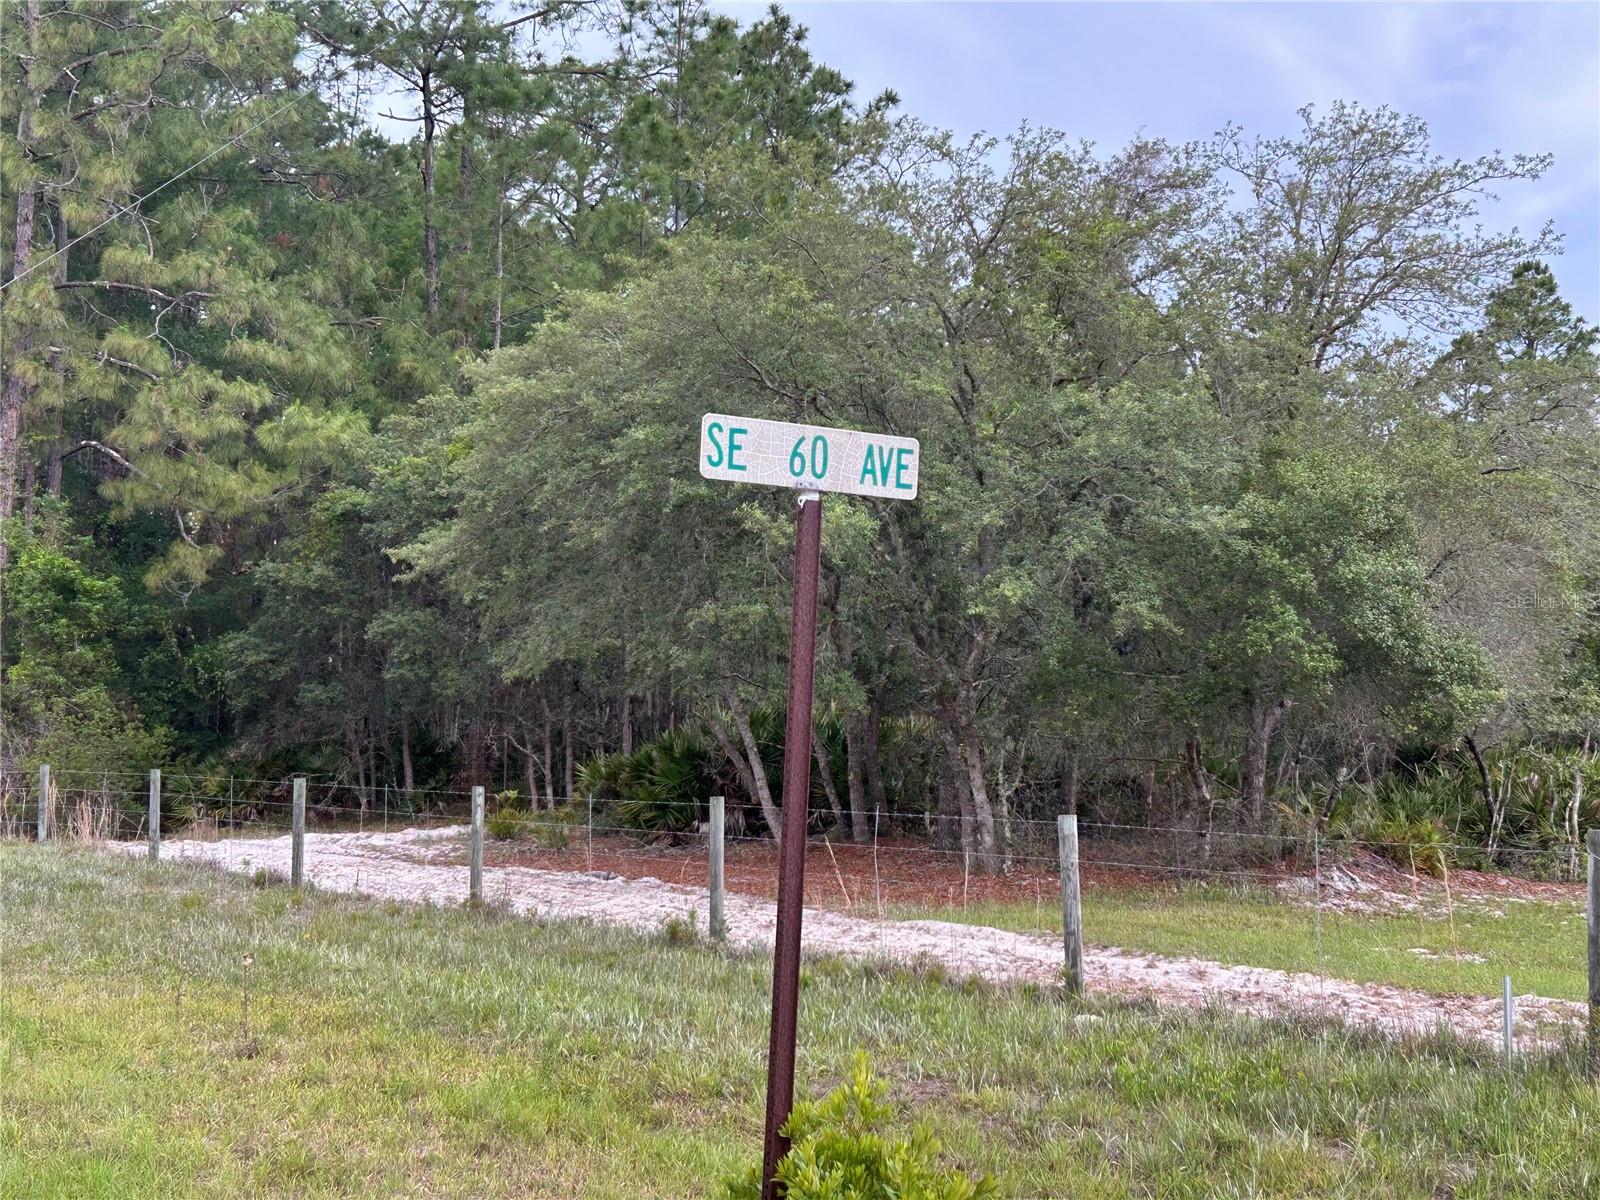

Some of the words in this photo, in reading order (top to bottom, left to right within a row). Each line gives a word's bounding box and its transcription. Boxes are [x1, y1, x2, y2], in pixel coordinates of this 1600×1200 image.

[707, 422, 748, 471] SE
[789, 435, 828, 479] 60
[859, 443, 914, 490] AVE
